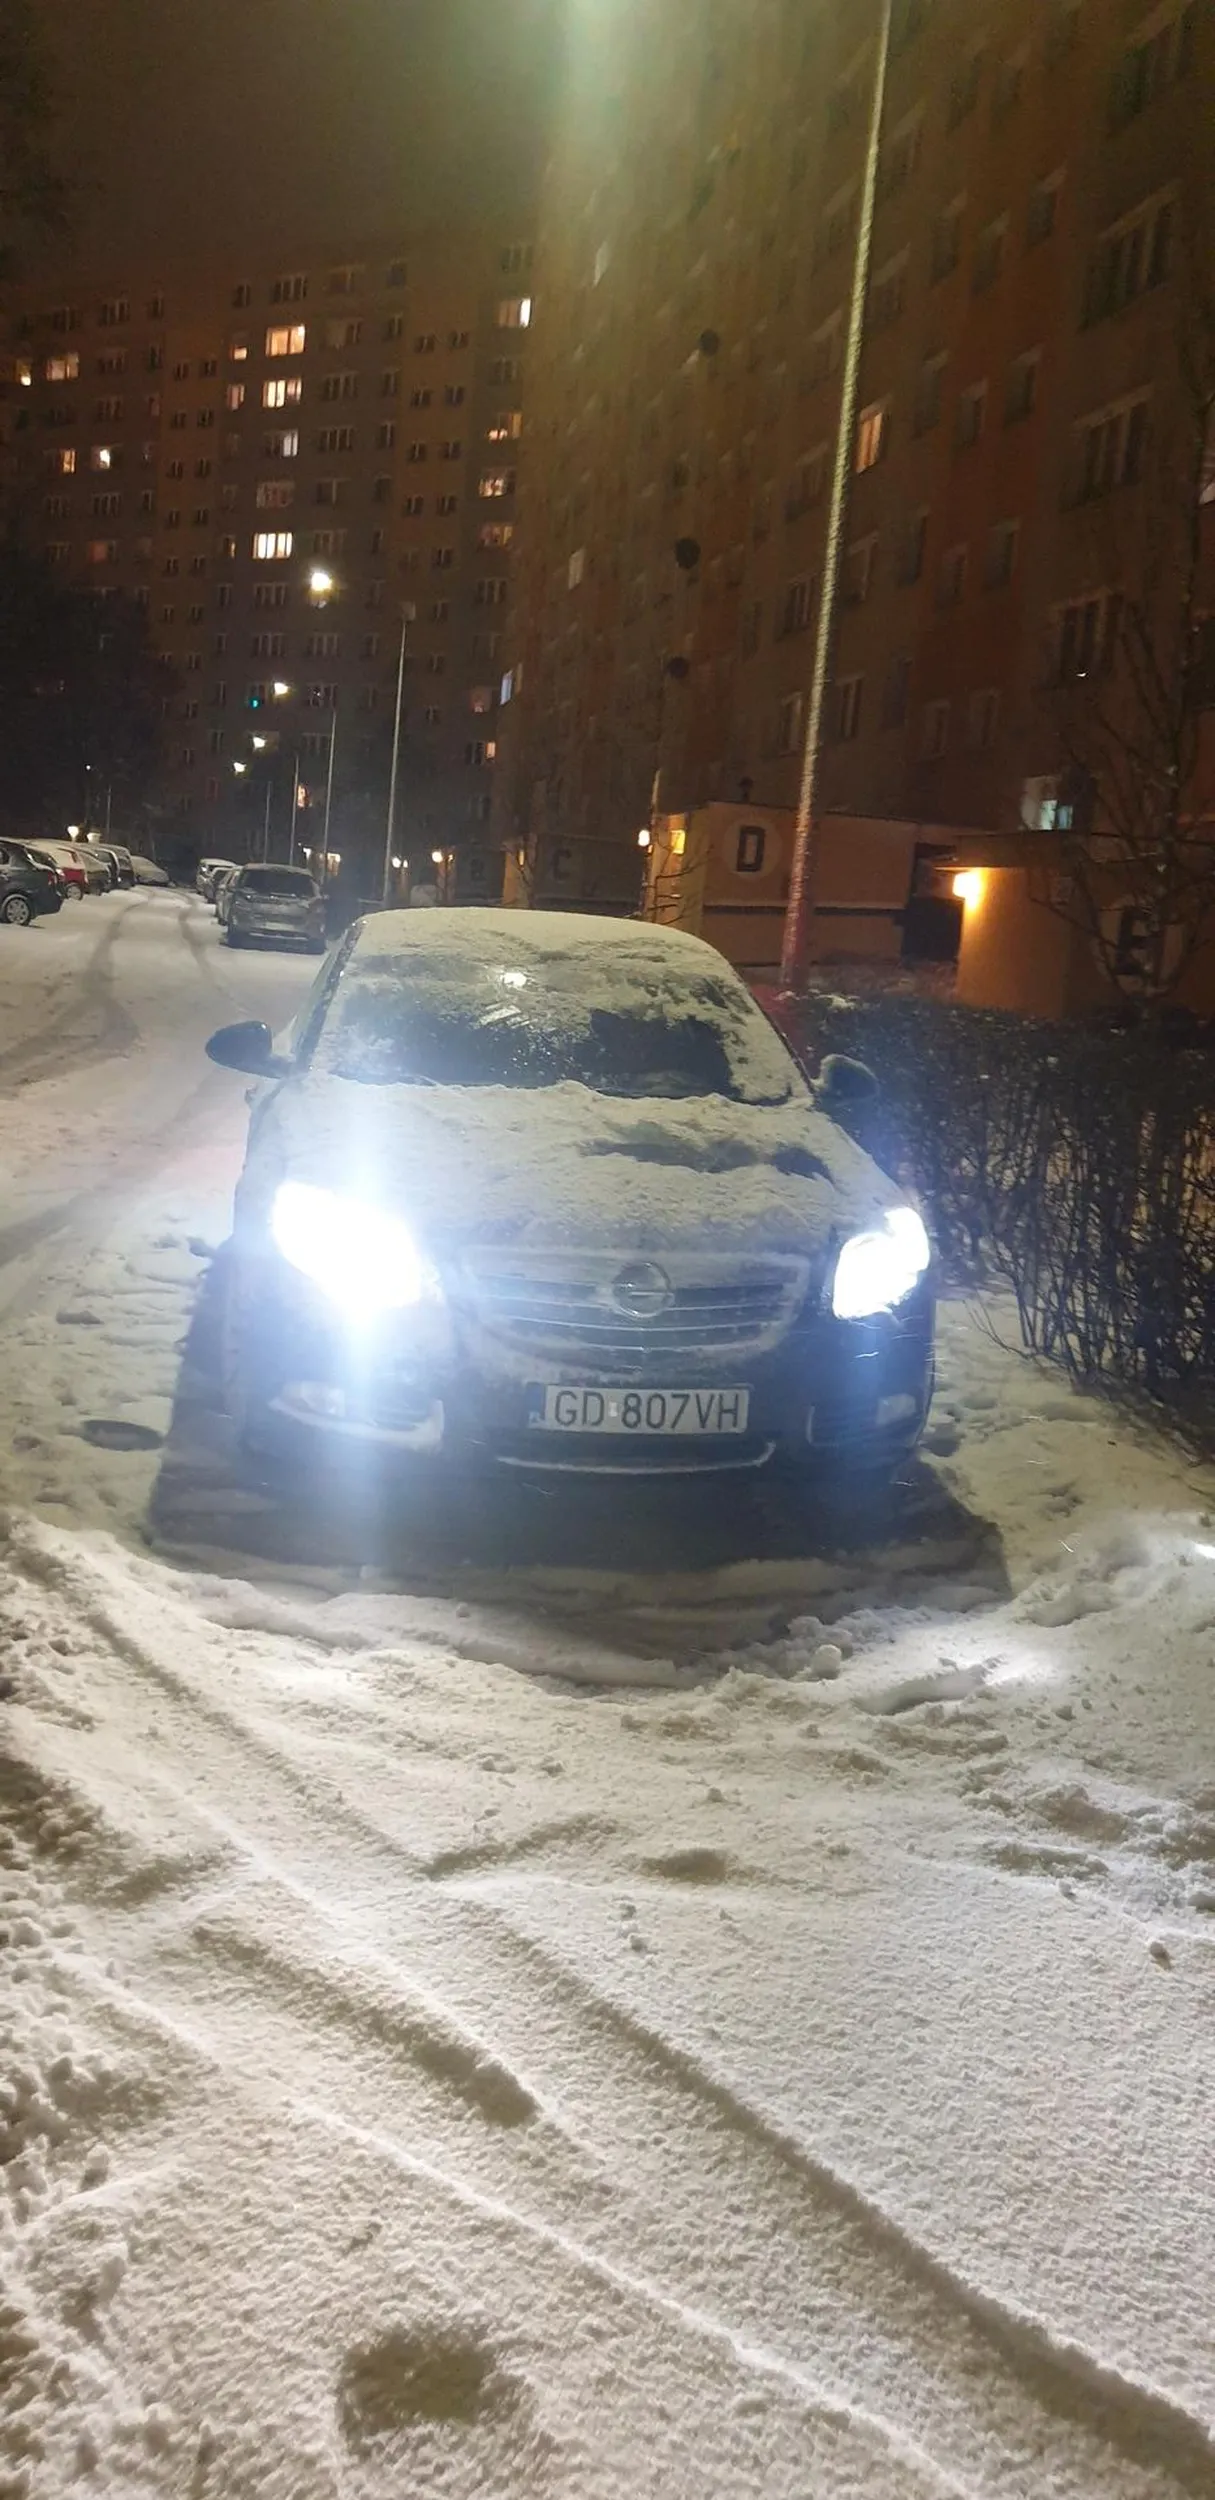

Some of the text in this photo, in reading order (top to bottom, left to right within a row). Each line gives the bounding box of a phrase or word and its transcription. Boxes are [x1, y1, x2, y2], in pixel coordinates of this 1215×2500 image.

[736, 825, 766, 872] D
[553, 1389, 605, 1428] GD
[620, 1391, 740, 1430] 807VH
